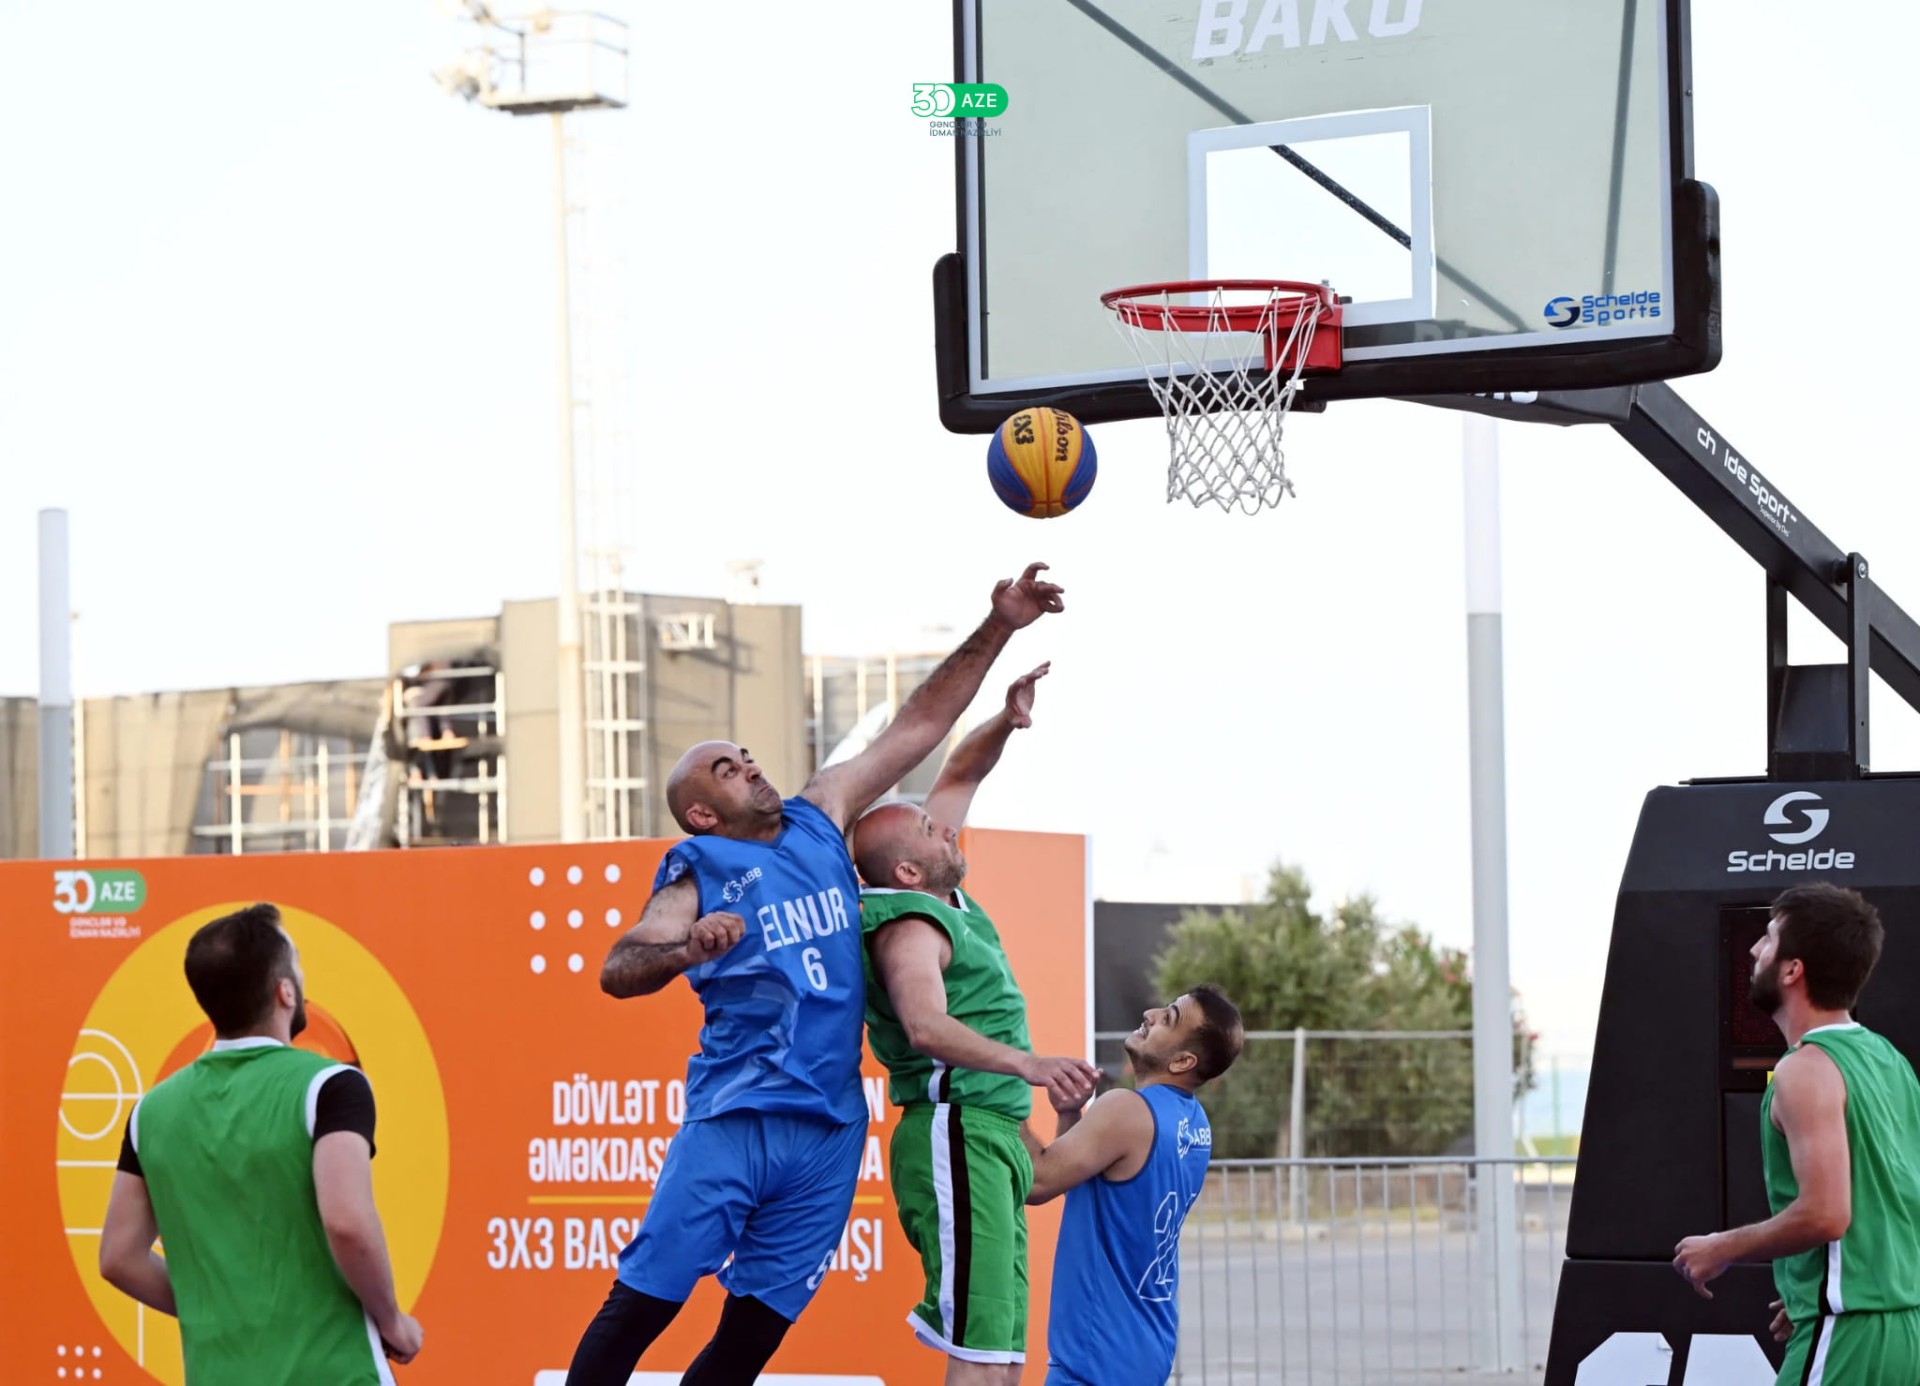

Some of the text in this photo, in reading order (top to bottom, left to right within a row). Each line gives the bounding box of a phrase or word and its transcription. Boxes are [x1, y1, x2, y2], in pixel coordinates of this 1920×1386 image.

[1582, 290, 1661, 309] Schelde
[1582, 305, 1661, 326] Sports
[1727, 848, 1855, 872] Schelde
[52, 870, 96, 914] 30
[100, 881, 136, 902] AZE
[741, 867, 763, 888] ABB
[756, 886, 849, 952] ELNUR
[801, 946, 828, 991] 6
[552, 1073, 660, 1125] DÖVLƏT
[1193, 1127, 1212, 1146] ABB
[528, 1137, 672, 1190] ƏMƏKDAŞ
[487, 1217, 554, 1270] 3X3
